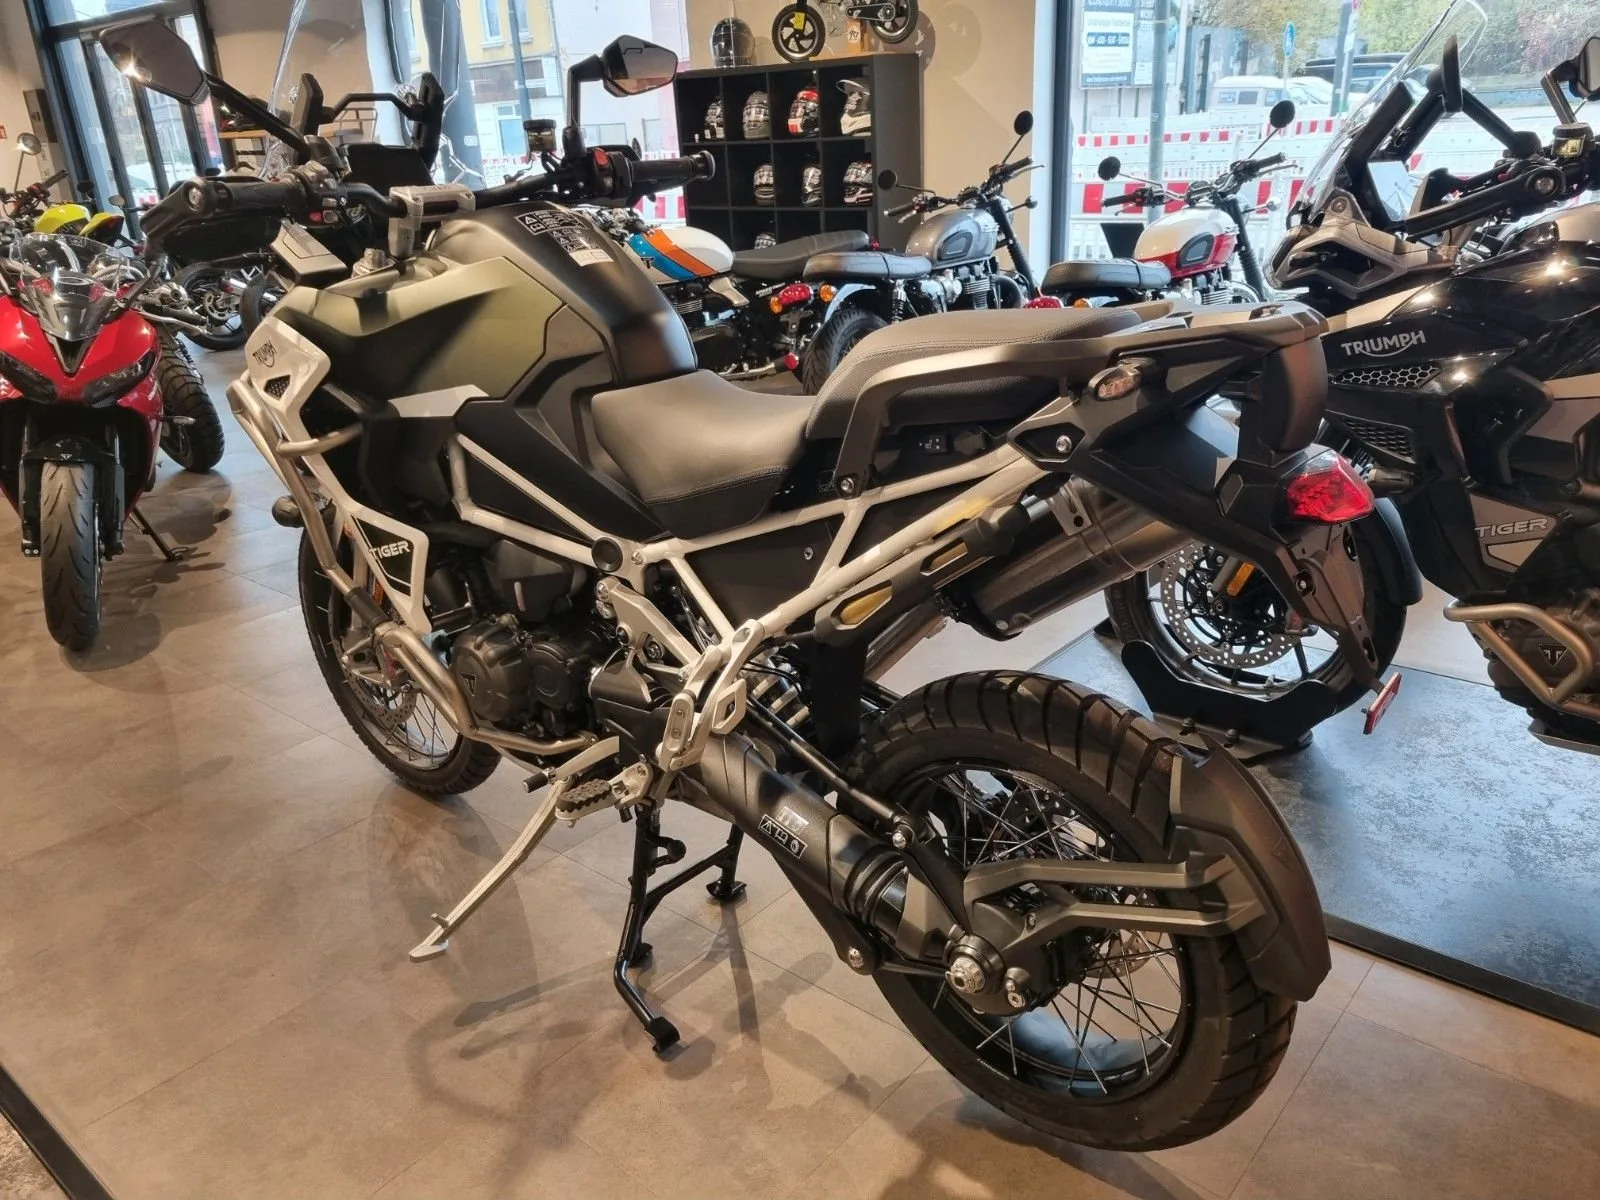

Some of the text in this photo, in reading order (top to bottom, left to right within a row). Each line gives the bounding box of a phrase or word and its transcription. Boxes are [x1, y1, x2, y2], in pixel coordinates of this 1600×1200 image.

[252, 340, 278, 368] TRIUMPH
[1341, 330, 1426, 357] TRIUMPH
[1474, 518, 1548, 538] TIGER
[368, 540, 411, 560] TIGER
